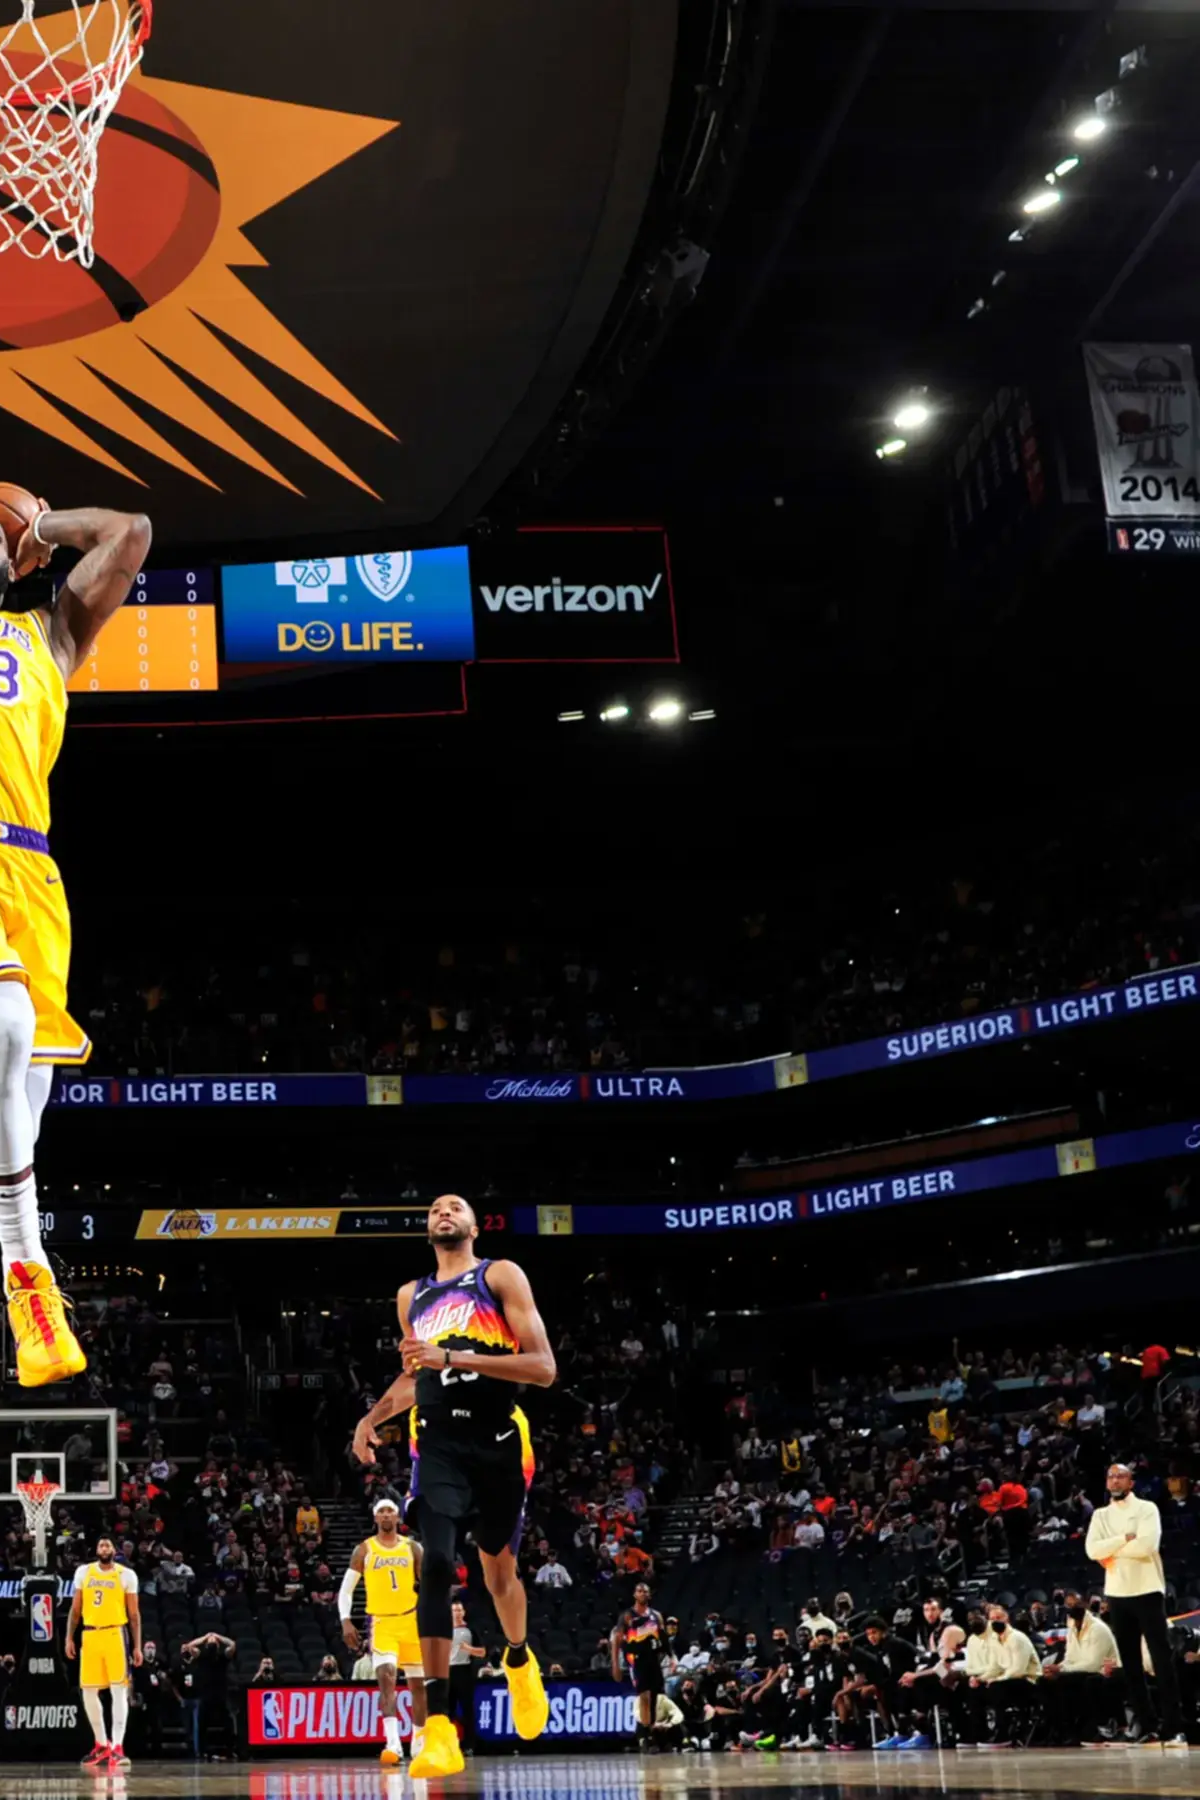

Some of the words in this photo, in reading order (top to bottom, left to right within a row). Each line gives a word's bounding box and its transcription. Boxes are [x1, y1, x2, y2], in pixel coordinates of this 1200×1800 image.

[1120, 474, 1200, 502] 2014
[1133, 528, 1165, 550] 29
[136, 572, 146, 585] 0
[186, 572, 196, 584] 0
[137, 590, 147, 602] 0
[187, 589, 197, 602] 0
[480, 577, 644, 612] verizon
[341, 622, 424, 651] LIFE.
[887, 1014, 1013, 1060] SUPERIOR
[1036, 992, 1116, 1028] LIGHT
[1125, 974, 1198, 1010] BEER
[127, 1082, 203, 1102] LIGHT
[212, 1082, 277, 1101] BEER
[485, 1078, 575, 1100] Michelob
[596, 1077, 684, 1097] ULTRA
[665, 1200, 792, 1229] SUPERIOR
[812, 1183, 884, 1214] LIGHT
[892, 1170, 955, 1200] BEER
[82, 1214, 94, 1239] 3
[225, 1216, 331, 1231] LAKERS
[484, 1214, 505, 1231] 23
[93, 1590, 103, 1606] 3
[16, 1705, 78, 1730] PLAYOFFS
[287, 1690, 413, 1738] PLAYOFS
